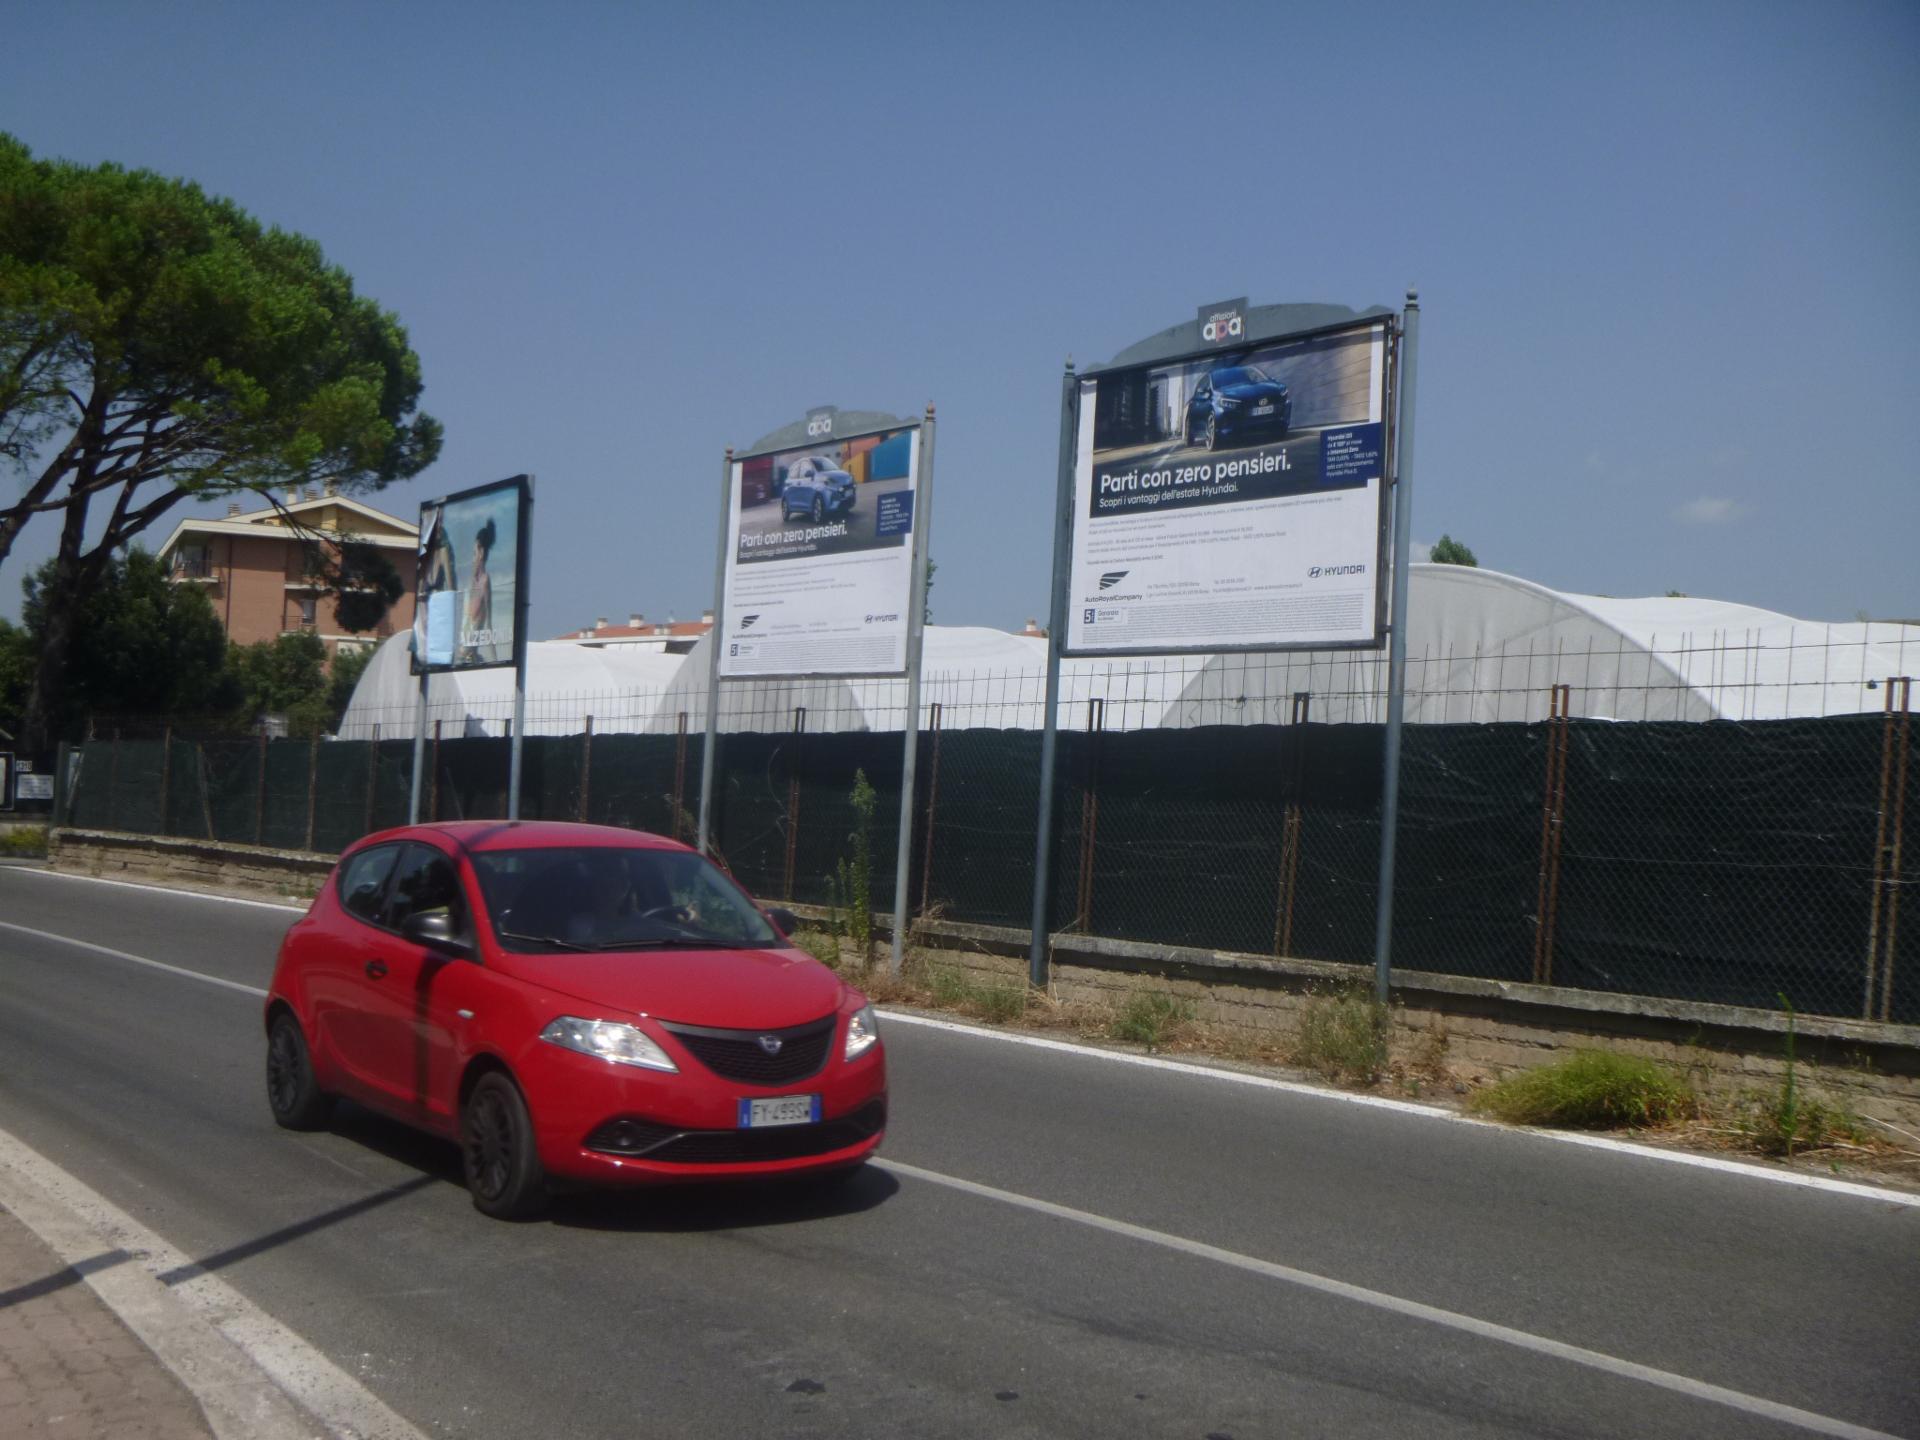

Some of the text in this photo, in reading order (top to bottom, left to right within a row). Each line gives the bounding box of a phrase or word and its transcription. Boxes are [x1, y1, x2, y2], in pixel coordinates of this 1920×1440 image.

[1100, 448, 1292, 494] Parti con zero pensieri.
[1099, 497, 1123, 509] Scopri
[1127, 493, 1161, 505] vantaggi
[1161, 488, 1201, 501] dell'estate
[1201, 481, 1239, 497] Hyundai.
[740, 519, 848, 548] Parti con zero pensieri.
[1324, 564, 1365, 576] HYUNDAI
